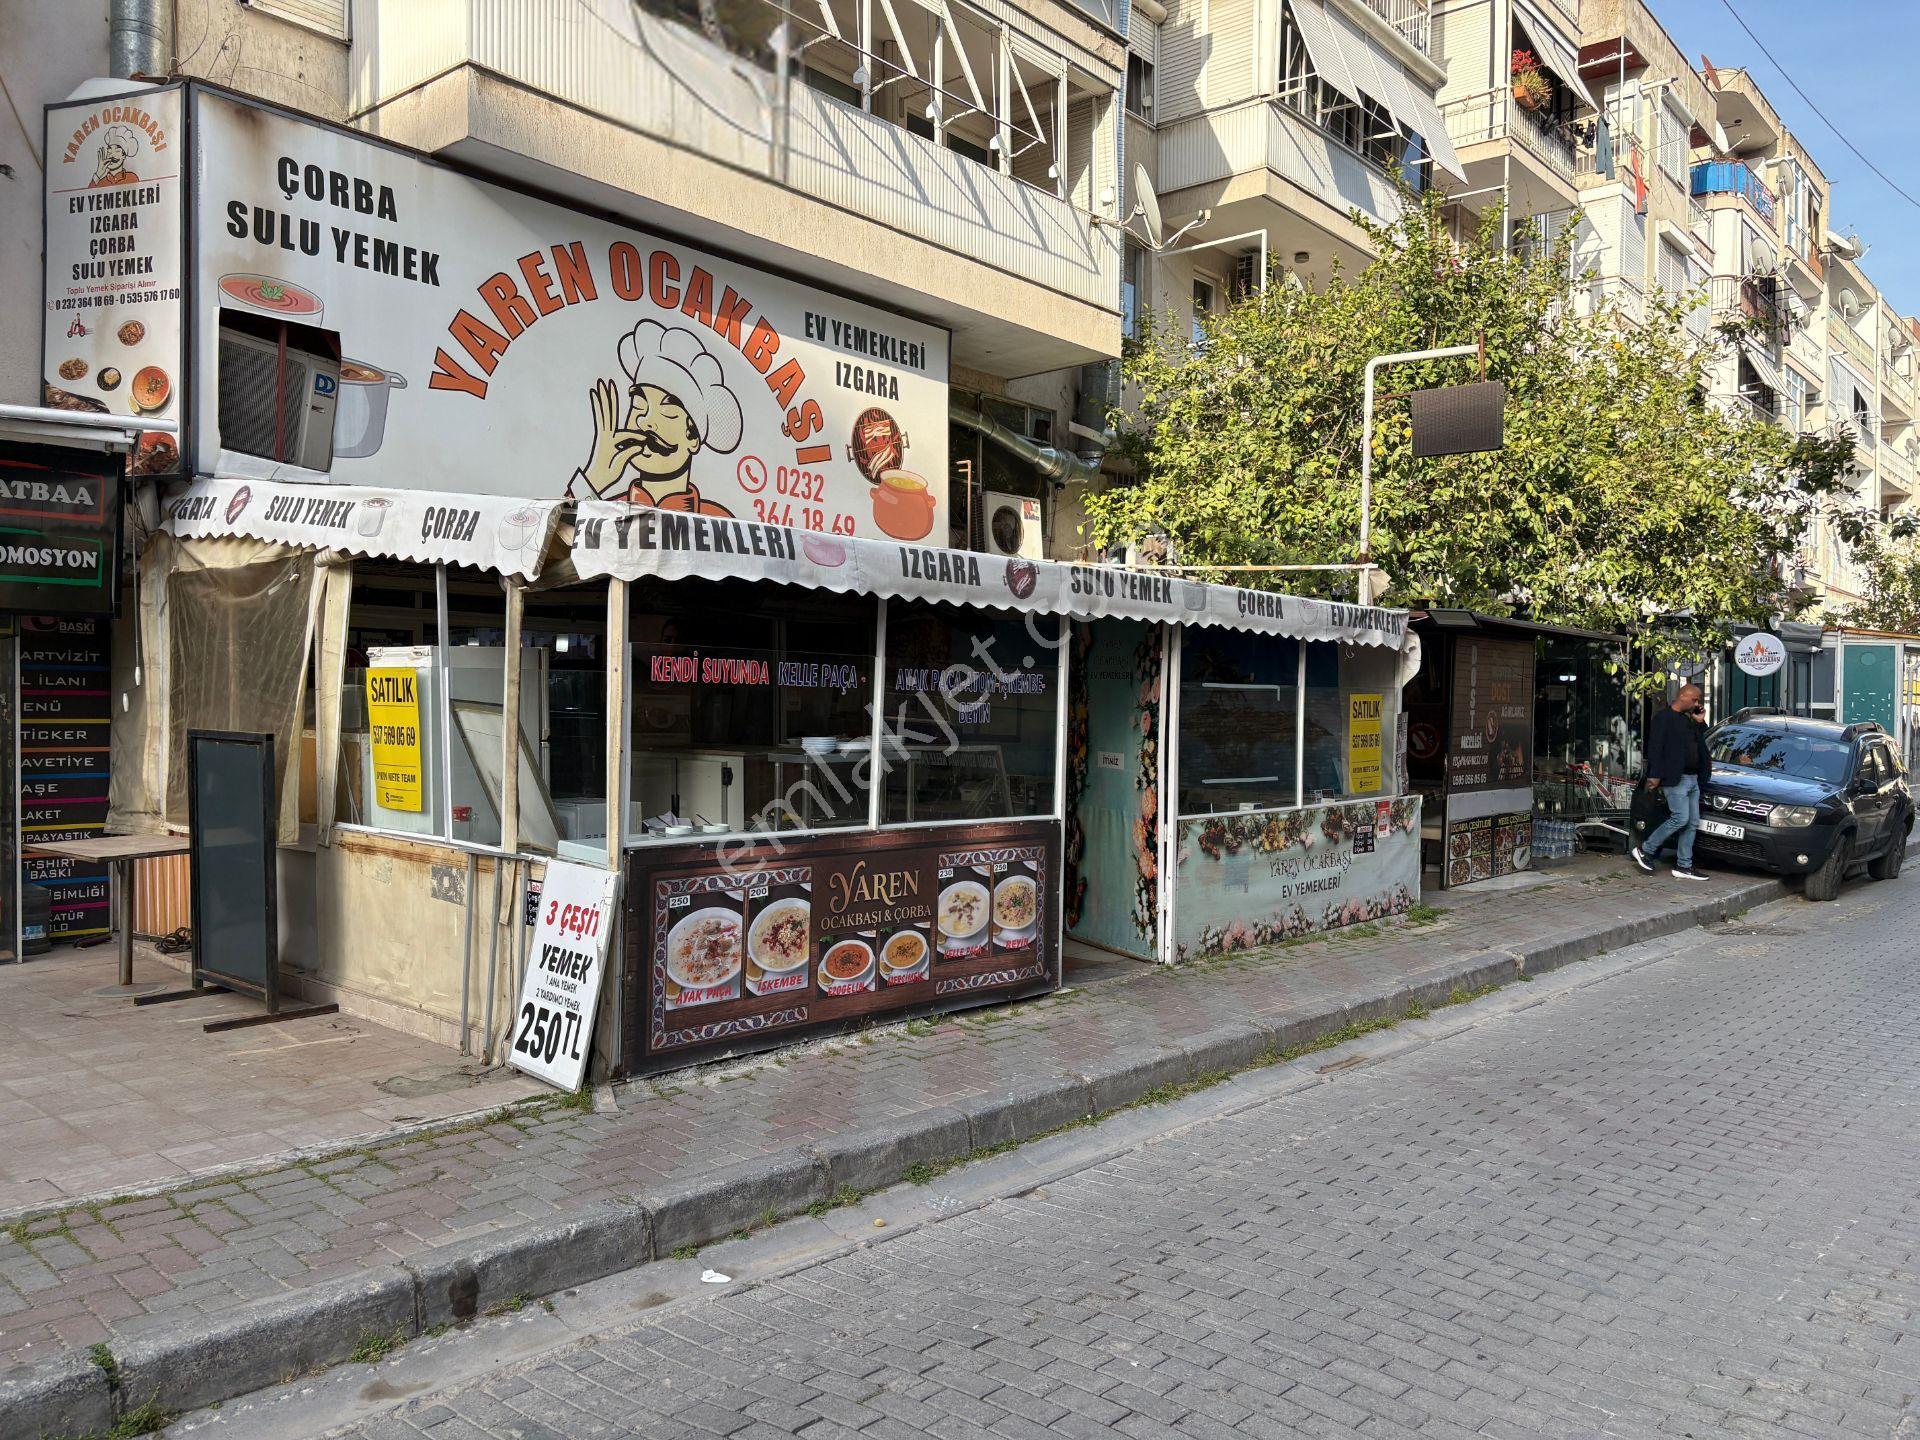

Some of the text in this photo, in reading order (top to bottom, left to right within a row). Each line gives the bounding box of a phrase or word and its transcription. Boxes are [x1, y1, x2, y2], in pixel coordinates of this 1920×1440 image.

[63, 106, 168, 164] YAREN OCAKBAŞI
[69, 184, 160, 214] EV YEMEKLERİ
[278, 157, 397, 222] ÇORBA
[90, 212, 138, 234] IZGARA
[90, 235, 135, 259] ÇORBA
[227, 200, 440, 287] SULU YEMEK
[72, 256, 153, 280] SULU YEMEK
[56, 300, 61, 310] 0
[62, 298, 76, 310] 232
[78, 297, 92, 308] 364
[94, 296, 103, 307] 18
[103, 295, 114, 306] 69
[120, 293, 126, 305] 0
[127, 292, 142, 303] 535
[144, 290, 158, 302] 576
[160, 289, 168, 301] 17
[169, 288, 180, 300] 60
[66, 286, 85, 296] Toplu
[87, 284, 109, 293] Yemek
[428, 241, 832, 466] YAREN OCAKBAŞI
[803, 311, 926, 371] EV YEMEKLERİ
[836, 361, 899, 402] IZGARA
[776, 465, 824, 502] 0232
[264, 495, 356, 529] SULU YEMEK
[753, 499, 855, 536] 364 18 69
[422, 507, 480, 544] ÇORBA
[571, 516, 601, 550] EV
[900, 546, 981, 587] IZGARA
[1071, 566, 1172, 604] SULU YEMEK
[1237, 590, 1284, 619] ÇORBA
[1331, 605, 1344, 626] EV
[59, 621, 95, 632] BASKI
[39, 674, 86, 687] İLANI
[651, 650, 770, 685] KENDİ SUYUNDA
[778, 661, 858, 695] KELLE PAÇA
[371, 677, 415, 703] SATILIK
[24, 699, 61, 712] ENÜ
[1352, 700, 1380, 719] SATILIK
[1707, 821, 1742, 837] HY 251
[24, 858, 76, 870] T-SHIRT
[30, 868, 71, 880] BASKI
[750, 887, 767, 897] 200
[829, 860, 920, 913] YAREN
[1282, 872, 1341, 898] EV YEMEKLERİ
[546, 901, 558, 925] 3
[670, 897, 689, 907] 250
[821, 906, 932, 930] OCAKBAŞI & ÇORBA
[539, 943, 593, 984] YEMEK
[536, 987, 540, 997] 2
[565, 996, 580, 1012] YEMEK
[561, 980, 577, 994] YEMEK
[675, 984, 732, 1005] AYAK PAÇA
